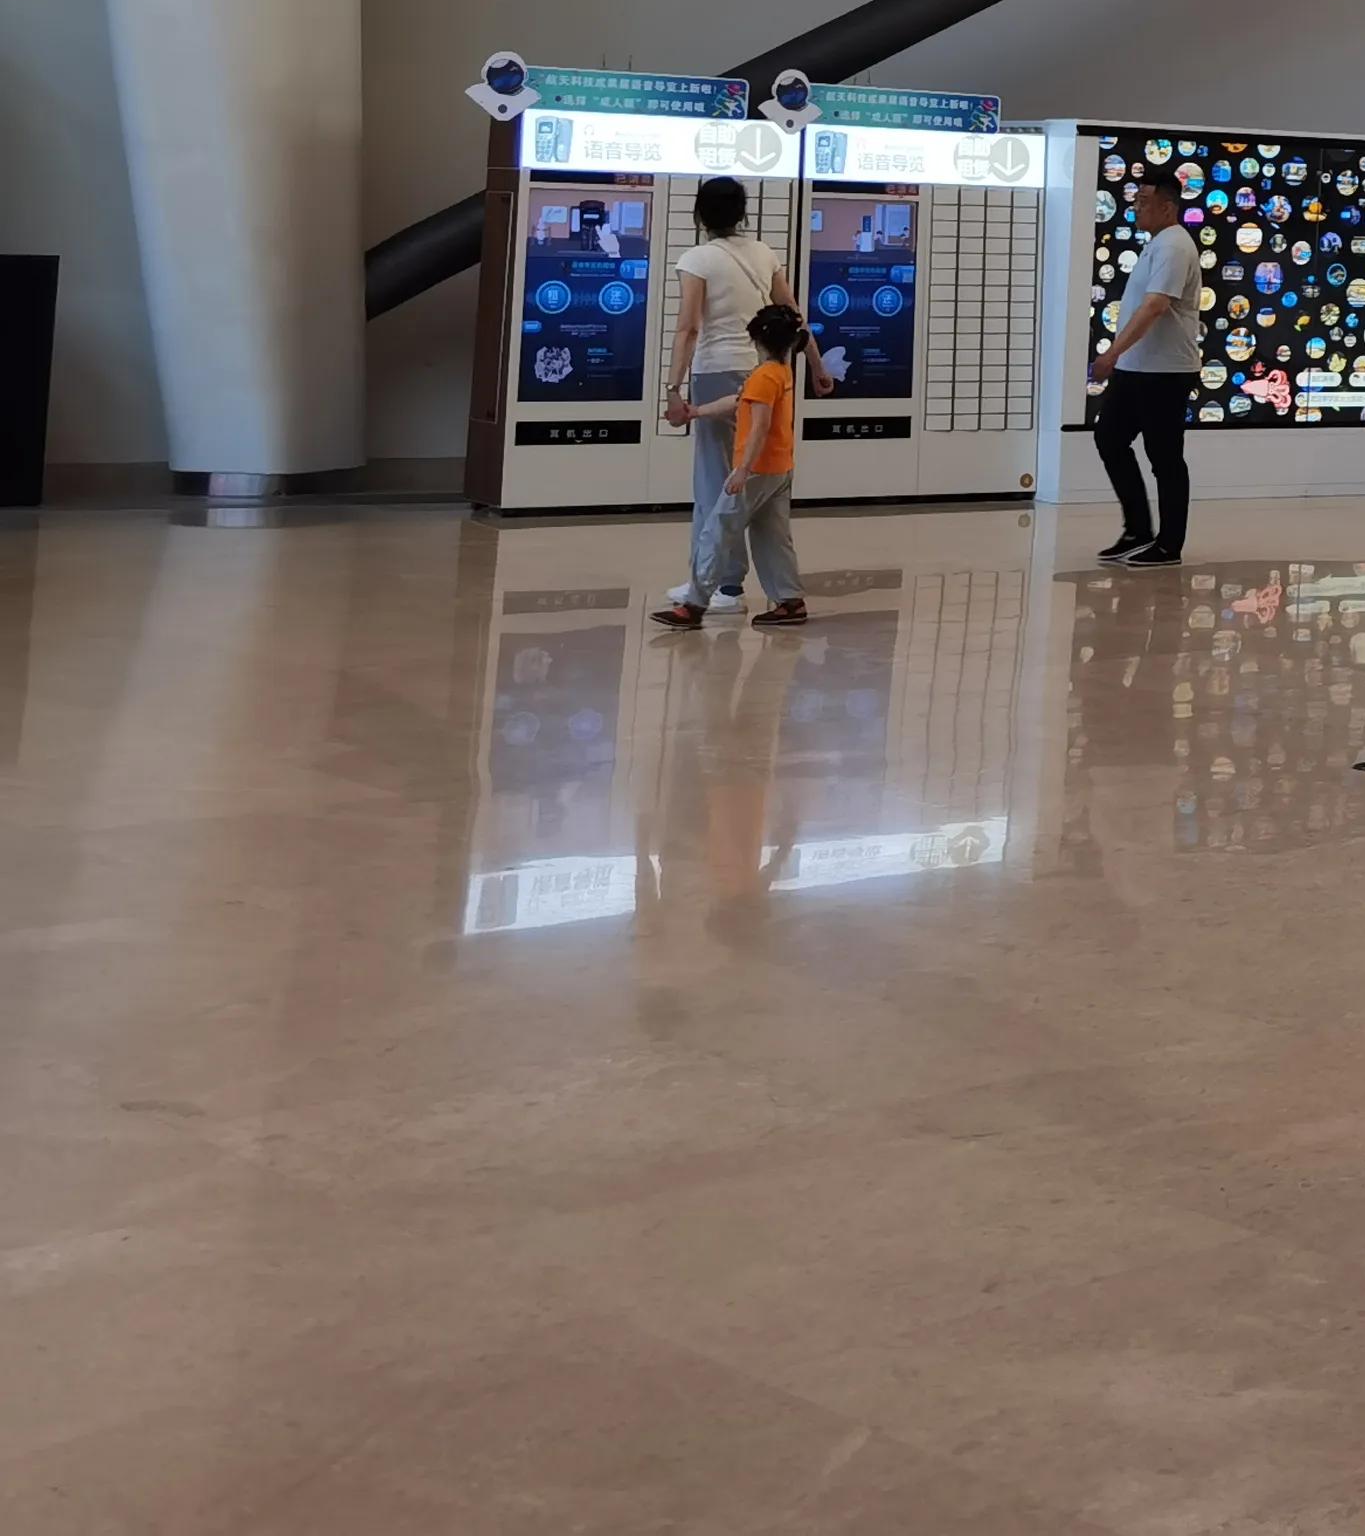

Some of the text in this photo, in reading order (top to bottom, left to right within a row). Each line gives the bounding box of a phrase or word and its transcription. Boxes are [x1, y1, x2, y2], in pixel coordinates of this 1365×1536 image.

[584, 140, 662, 161] 语音导览
[858, 152, 926, 173] 语音导览
